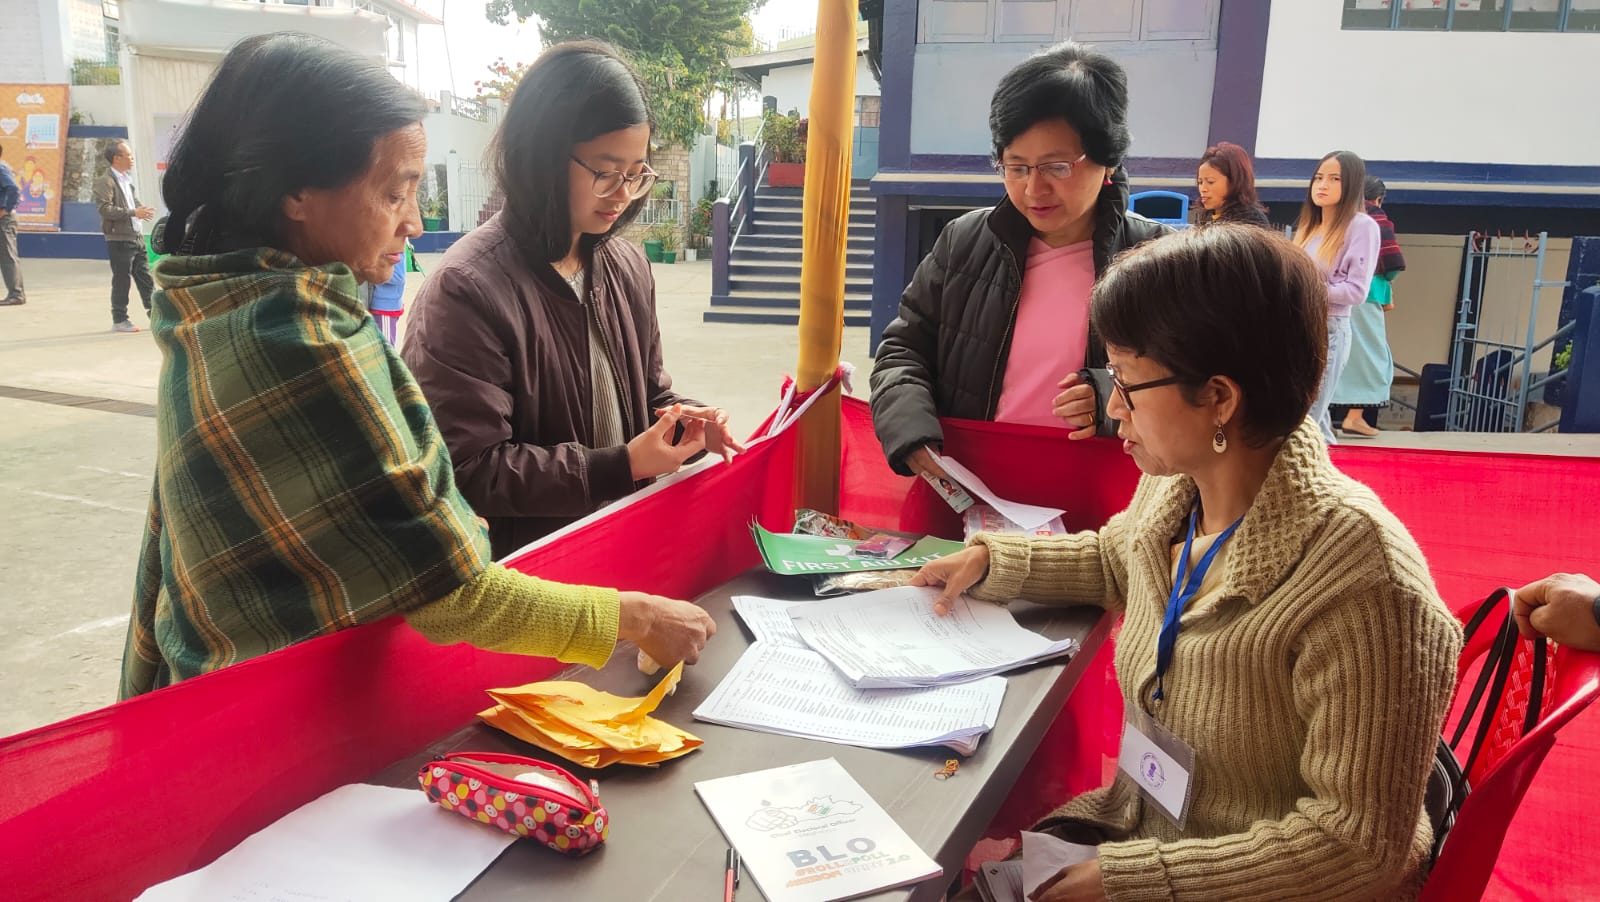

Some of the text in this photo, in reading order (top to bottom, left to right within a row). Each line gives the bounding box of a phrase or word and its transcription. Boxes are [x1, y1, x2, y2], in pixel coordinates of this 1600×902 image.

[782, 552, 941, 571] FIRST AID KIT
[786, 837, 877, 869] BLO
